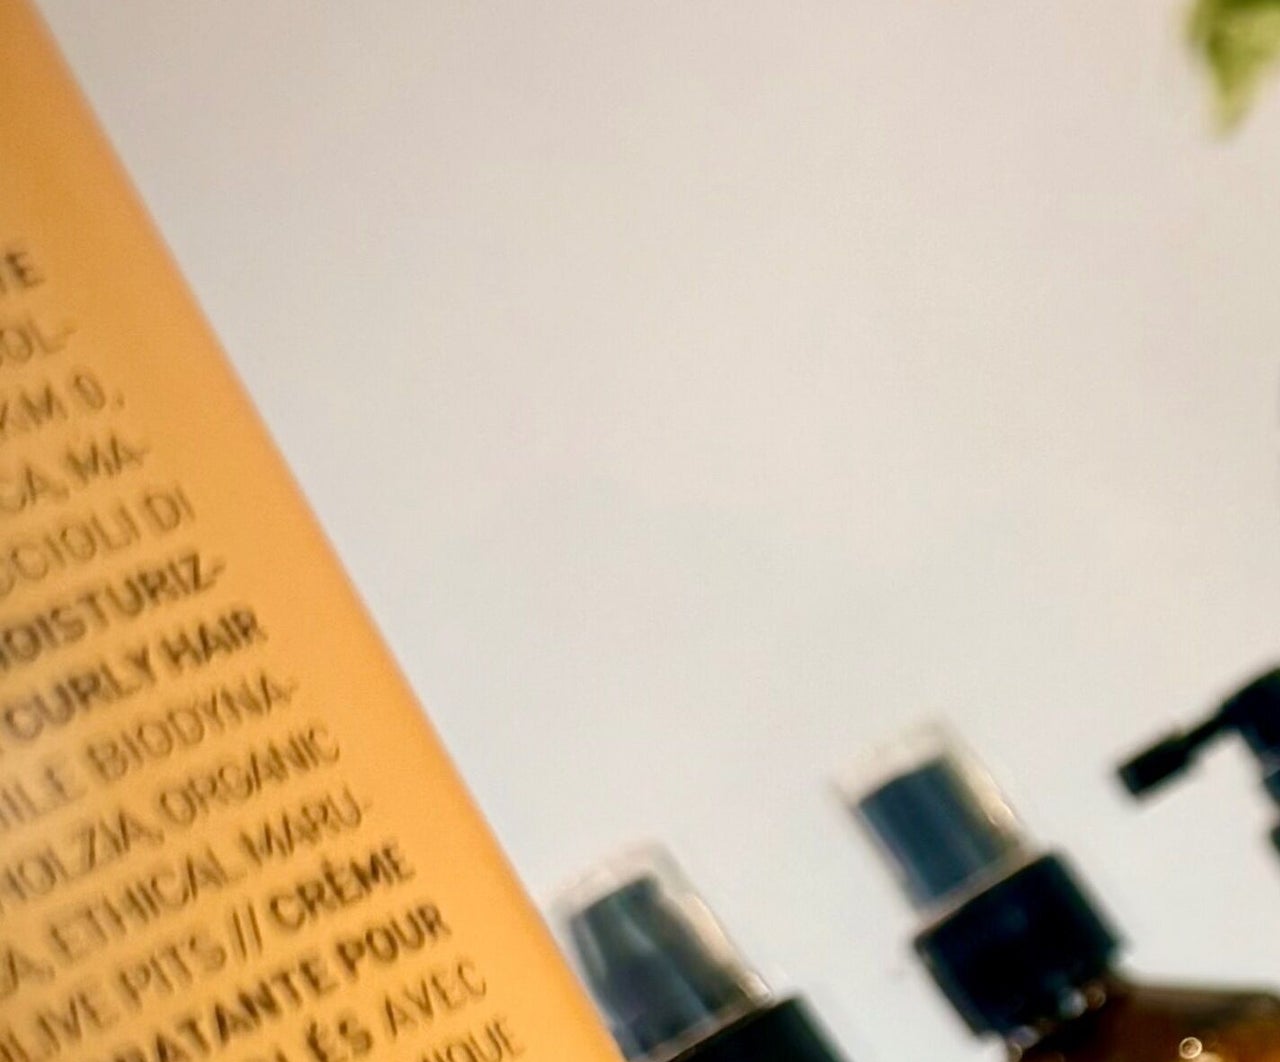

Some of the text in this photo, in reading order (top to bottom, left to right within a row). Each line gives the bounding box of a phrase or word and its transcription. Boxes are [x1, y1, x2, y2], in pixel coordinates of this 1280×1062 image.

[0, 552, 226, 673] OISTURIZ-
[3, 606, 269, 742] CURLY HAIR
[158, 727, 340, 827] ORGANIC
[47, 845, 248, 961] ETHICAL
[118, 927, 227, 1010] PITS
[269, 836, 417, 933] CRÈME
[336, 902, 452, 982] POUR
[384, 957, 487, 1038] AVEC
